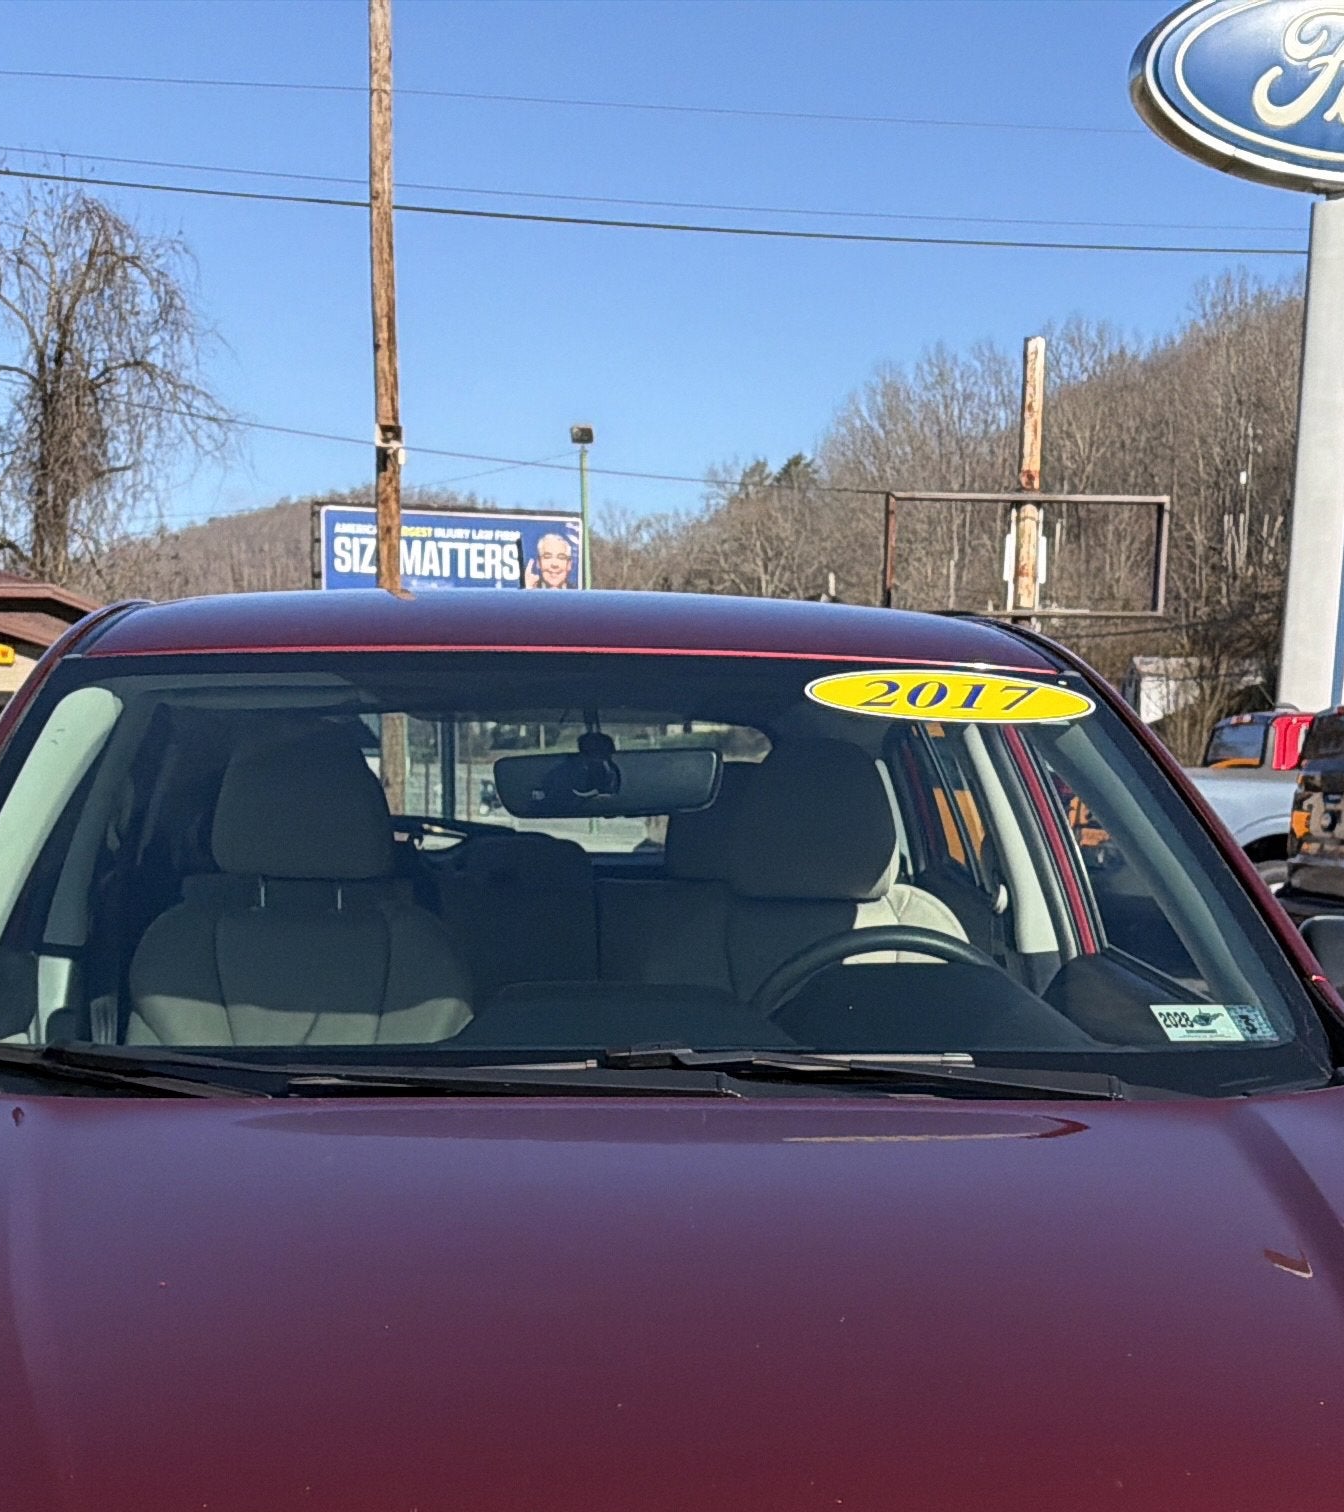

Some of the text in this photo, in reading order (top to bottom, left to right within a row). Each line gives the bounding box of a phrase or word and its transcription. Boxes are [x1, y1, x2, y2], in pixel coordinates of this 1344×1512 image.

[333, 536, 521, 581] SIZ MATTERS
[856, 679, 1041, 711] 2017
